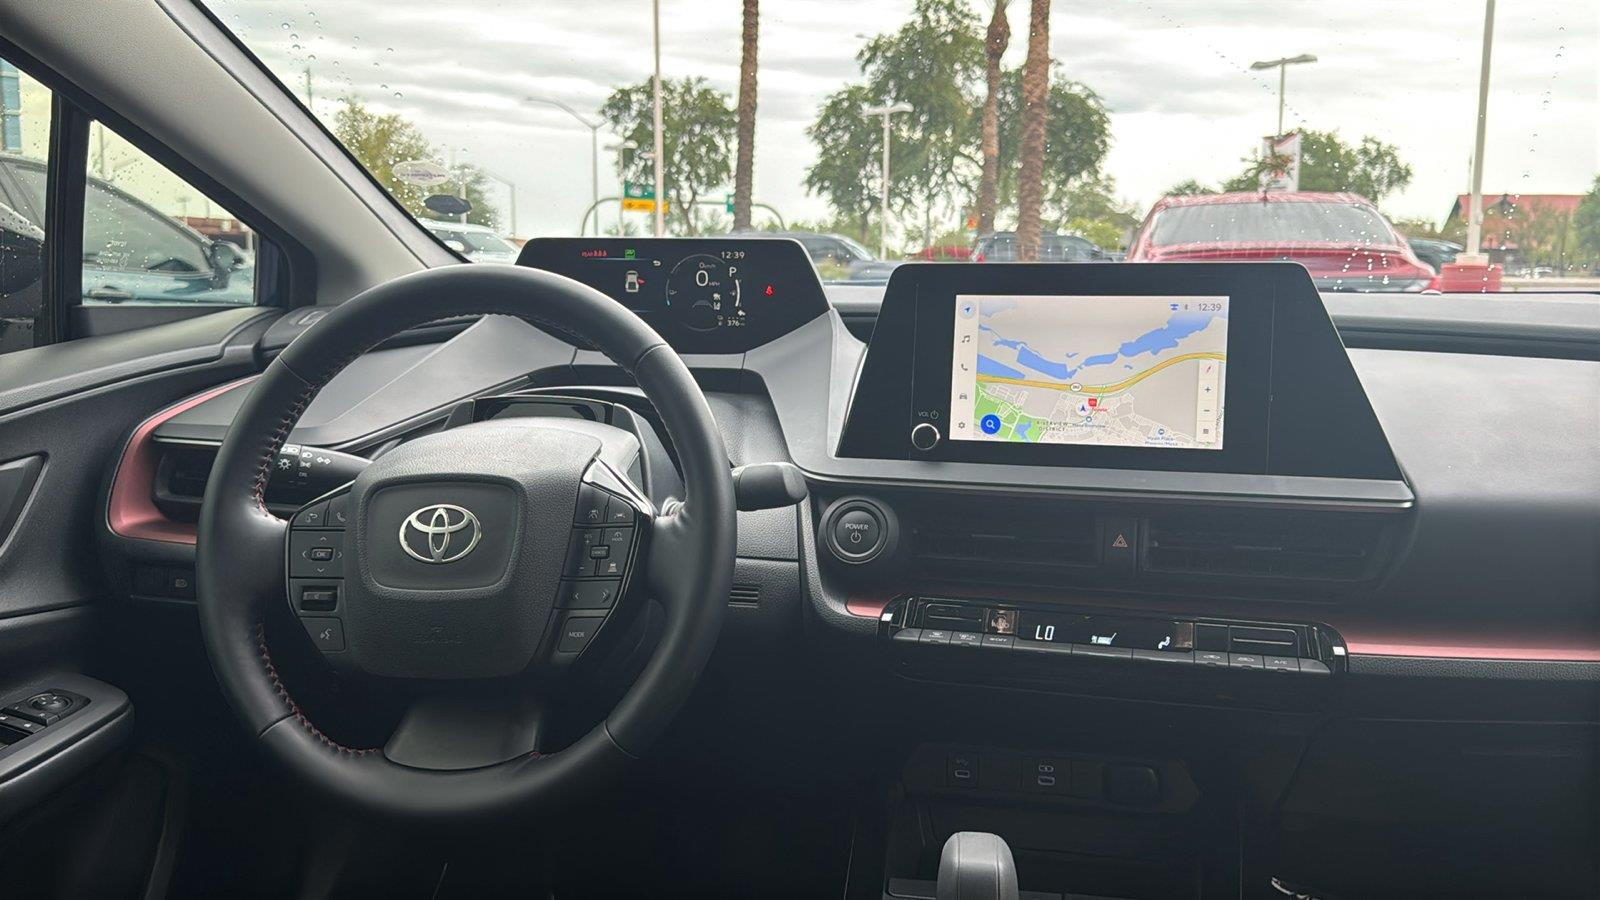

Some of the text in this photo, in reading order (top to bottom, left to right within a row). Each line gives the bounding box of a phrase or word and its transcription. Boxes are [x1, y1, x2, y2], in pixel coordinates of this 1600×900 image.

[721, 251, 745, 259] 12:39
[729, 266, 737, 277] P
[696, 270, 709, 287] 0
[1198, 303, 1222, 311] 12:39
[1035, 624, 1055, 641] LO
